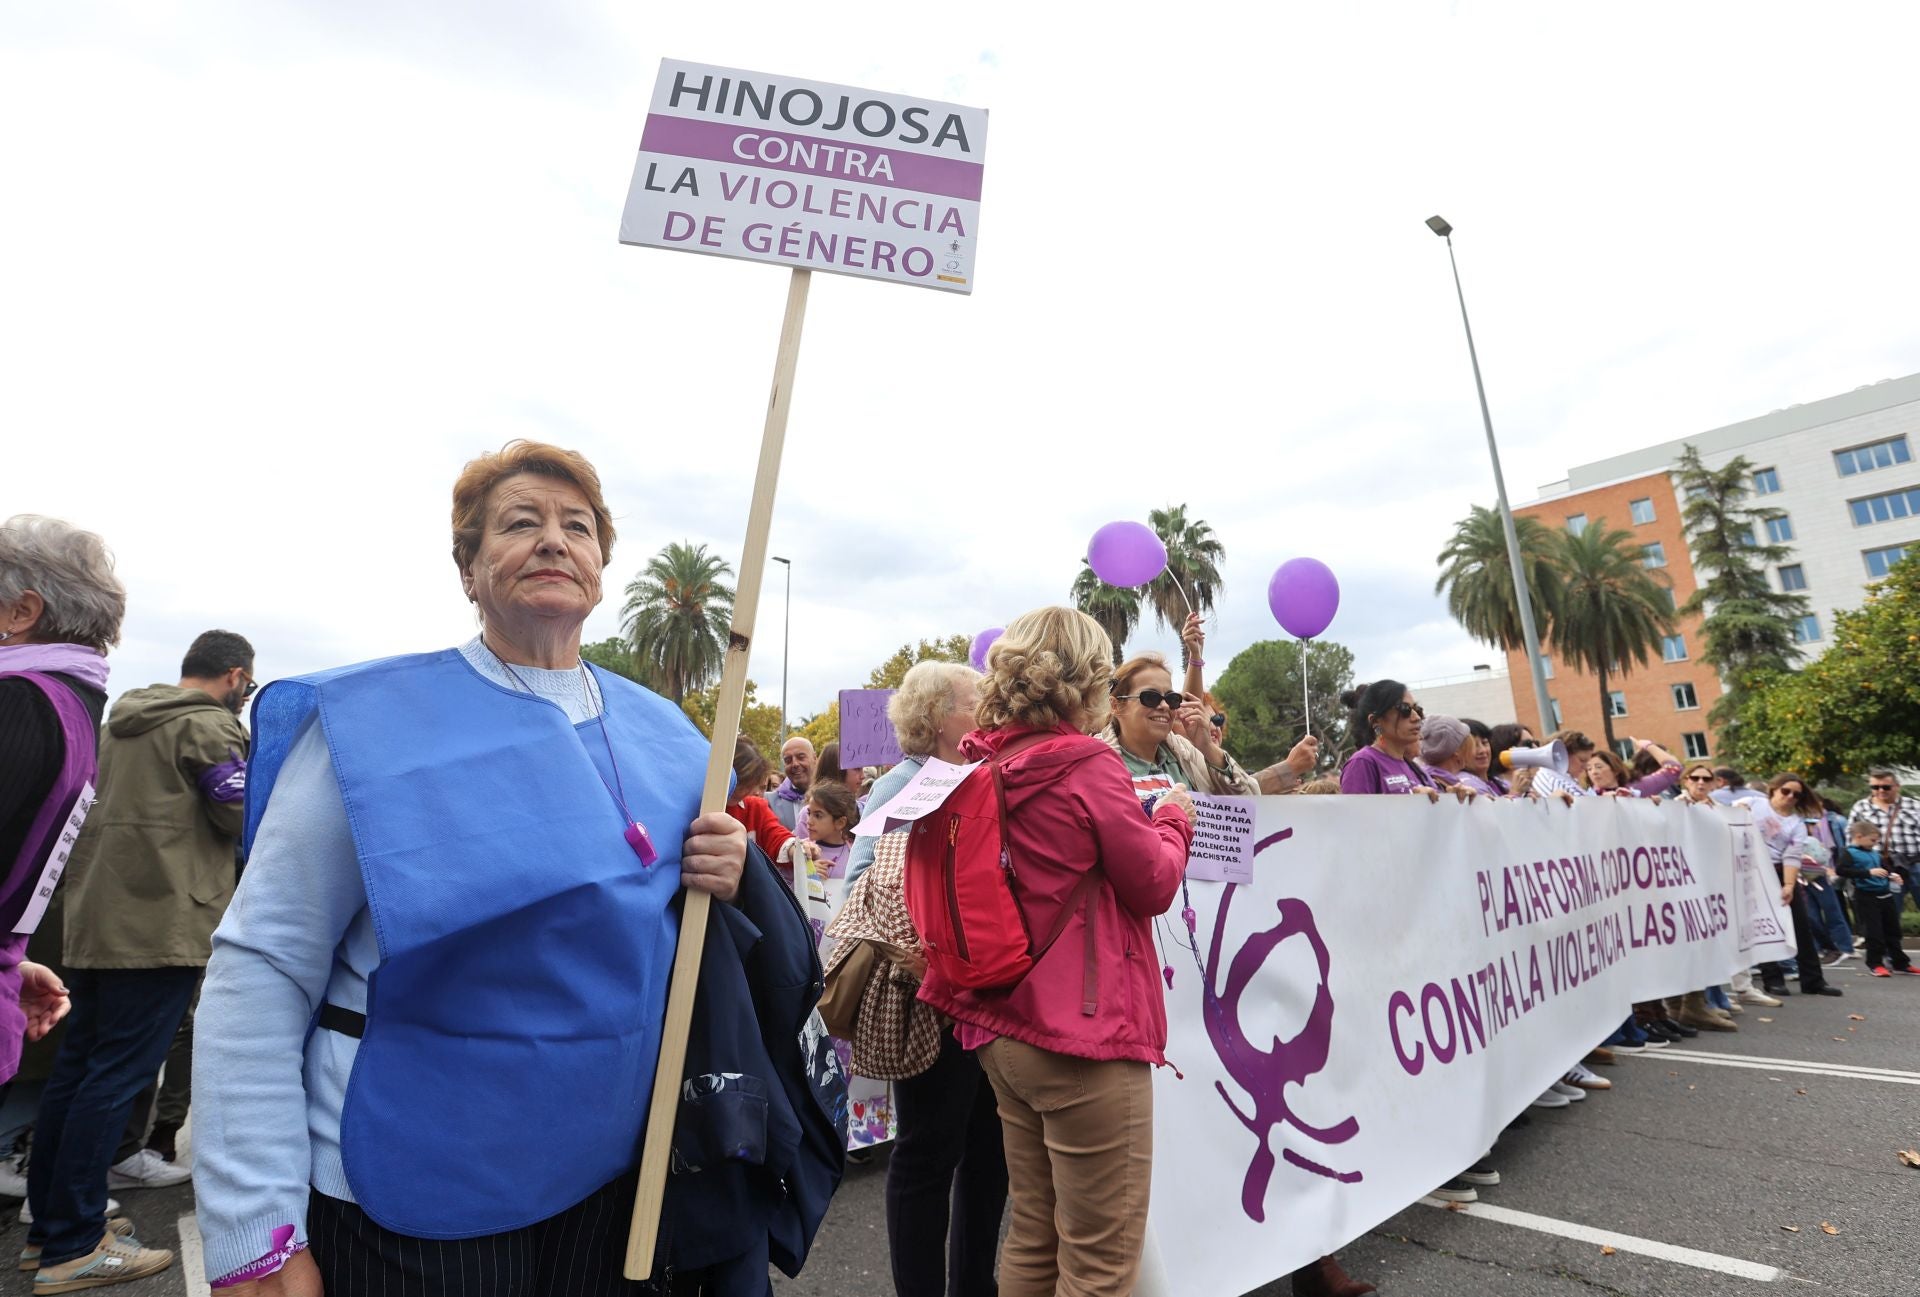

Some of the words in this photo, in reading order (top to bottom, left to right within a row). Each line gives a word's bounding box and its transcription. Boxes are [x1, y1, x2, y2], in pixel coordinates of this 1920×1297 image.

[668, 71, 971, 152] HINOJOSA
[732, 133, 895, 181] CONTRA
[644, 162, 700, 196] LA
[719, 171, 966, 237] VIOLENCIA
[662, 210, 726, 247] DE
[741, 222, 934, 277] GÉNERO
[1192, 800, 1231, 812] RABAJAR
[1234, 806, 1247, 814] LA
[1196, 810, 1222, 821] ALDAD
[1225, 815, 1251, 824] PARA
[1189, 851, 1241, 863] MACHISTAS.
[1190, 841, 1241, 853] VIOLENCIAS
[1223, 835, 1239, 843] SIN
[1477, 854, 1600, 937] PLATAFORMA
[1388, 957, 1519, 1075] CONTRA
[1512, 945, 1545, 1013] LA
[1547, 912, 1626, 995] VIOLENCIA
[1628, 902, 1676, 948] LAS
